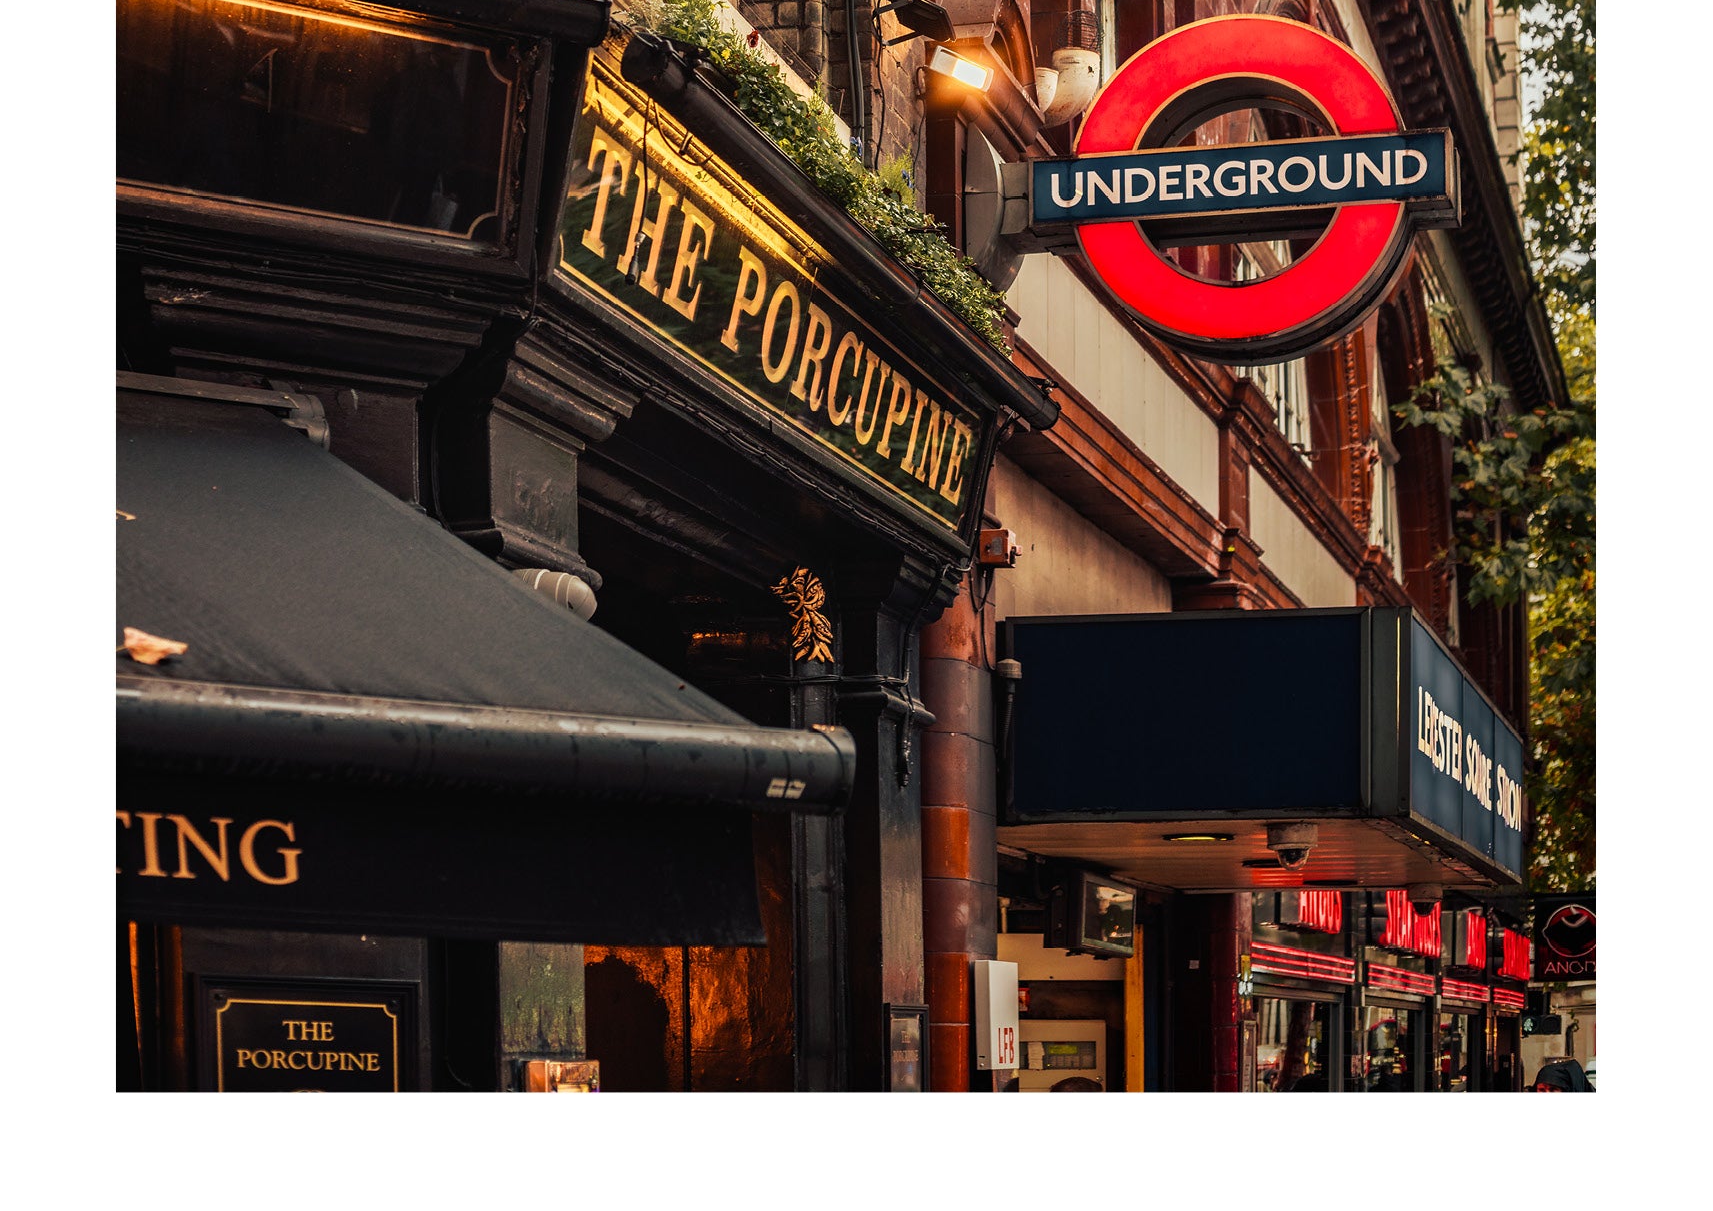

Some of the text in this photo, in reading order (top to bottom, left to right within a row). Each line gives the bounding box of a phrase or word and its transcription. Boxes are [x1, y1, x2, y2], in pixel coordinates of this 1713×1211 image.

[1051, 148, 1429, 209] UNDERGROUND
[581, 125, 975, 507] THE PORCUPINE
[282, 1020, 334, 1042] THE
[998, 1027, 1015, 1065] LFB
[236, 1049, 381, 1072] PORCUPINE
